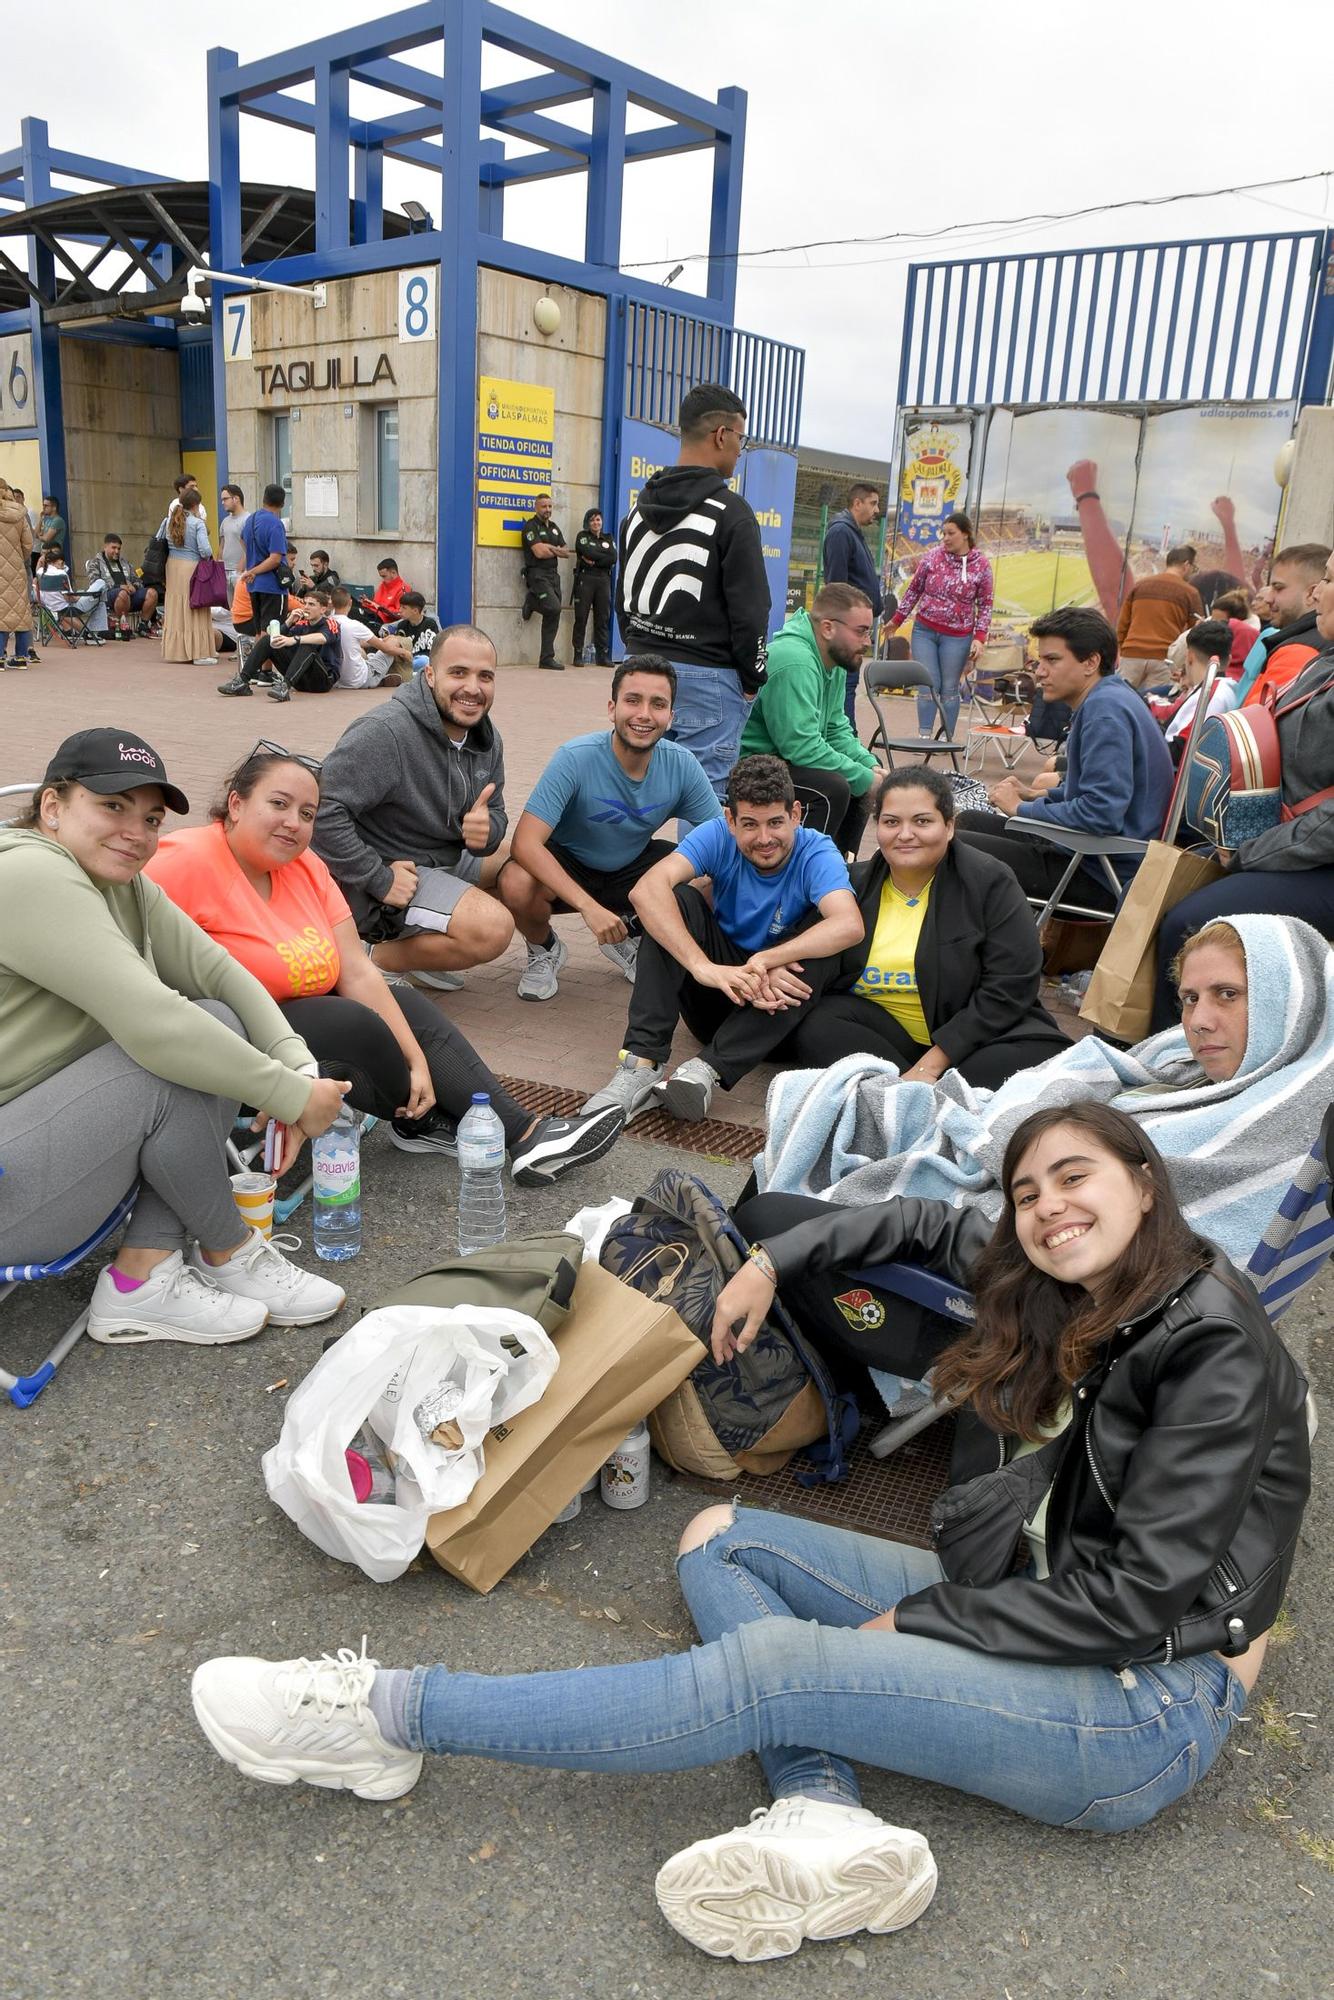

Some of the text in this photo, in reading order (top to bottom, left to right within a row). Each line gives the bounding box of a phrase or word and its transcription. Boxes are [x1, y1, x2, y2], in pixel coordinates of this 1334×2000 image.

[406, 276, 429, 337] 8
[228, 304, 246, 356] 7
[9, 350, 28, 409] 6
[254, 353, 396, 395] TAQUILLA
[1200, 408, 1290, 419] udlaspalmas.es
[481, 436, 551, 455] TIENDA OFICIAL
[480, 465, 551, 483] OFFICIAL STORE
[631, 456, 664, 480] Bie
[480, 495, 536, 508] OFFIZIELLER ST
[755, 508, 782, 528] aria
[762, 544, 780, 558] dium
[120, 753, 156, 768] MOOD
[862, 966, 915, 985] Gra
[317, 1161, 355, 1175] aquavia
